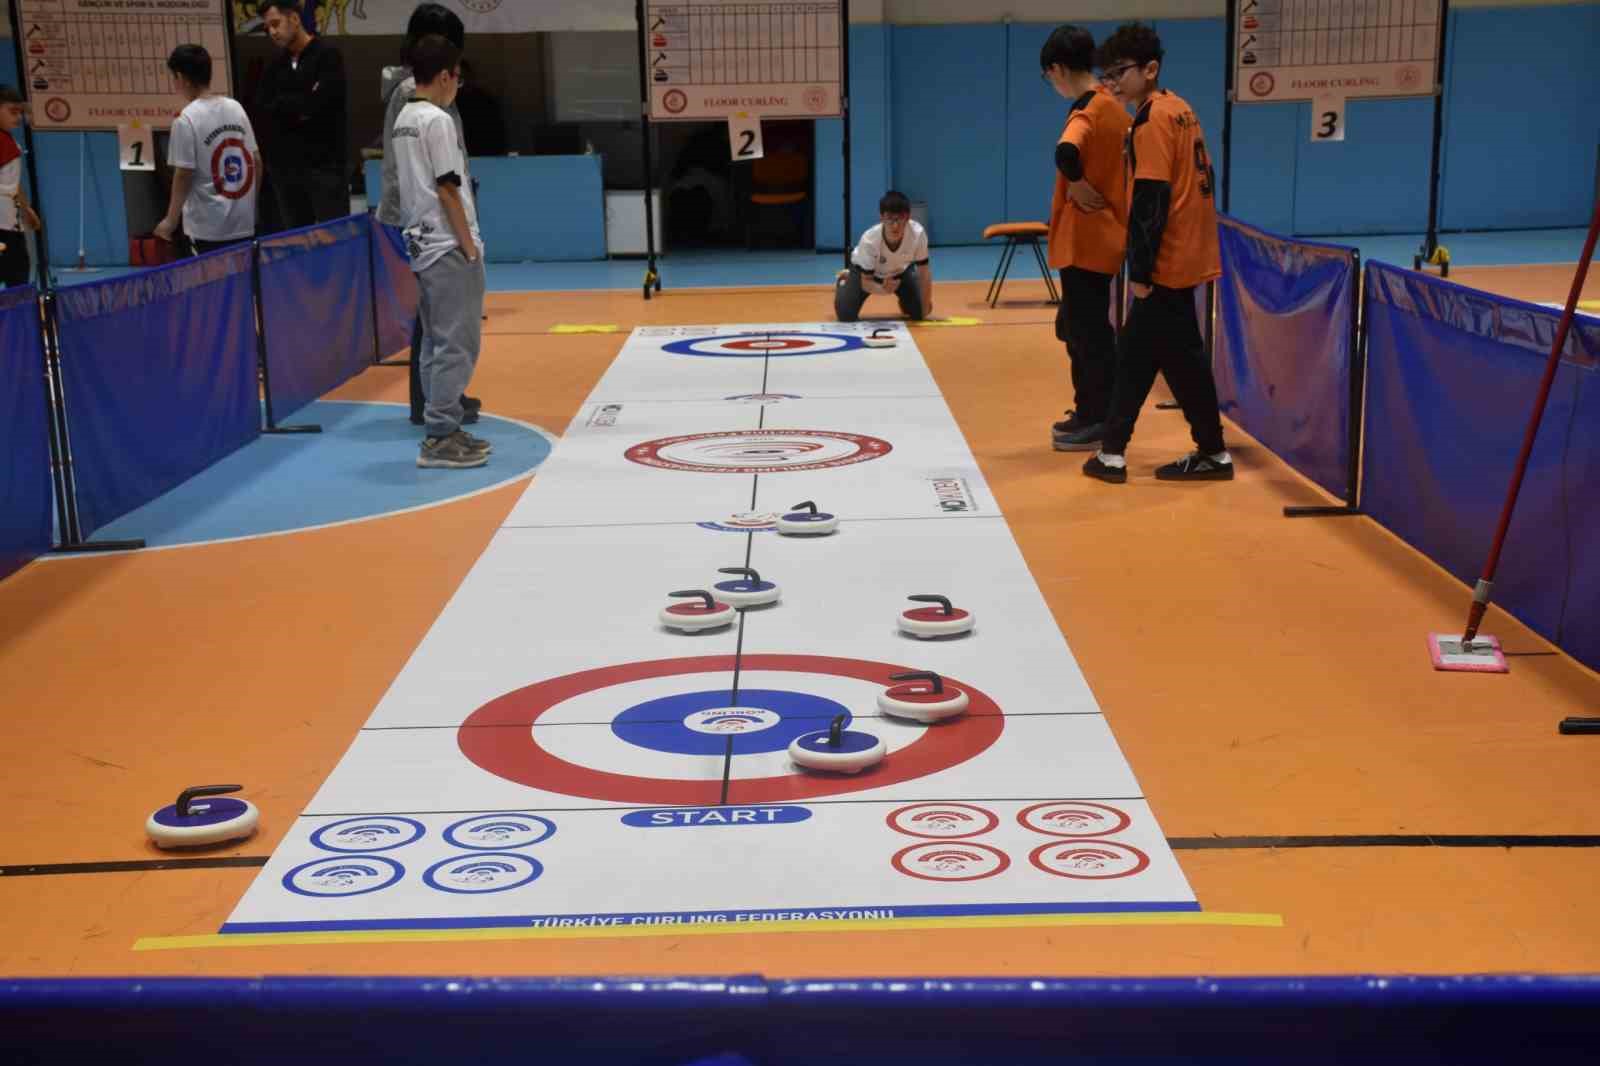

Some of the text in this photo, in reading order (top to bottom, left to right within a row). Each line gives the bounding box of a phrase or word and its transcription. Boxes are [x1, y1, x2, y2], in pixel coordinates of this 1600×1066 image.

[1316, 111, 1337, 138] 3
[128, 141, 144, 166] 1
[738, 130, 756, 156] 2
[650, 808, 783, 825] START
[531, 909, 894, 929] TÜRKİYE CURLING FEDERASYONU
